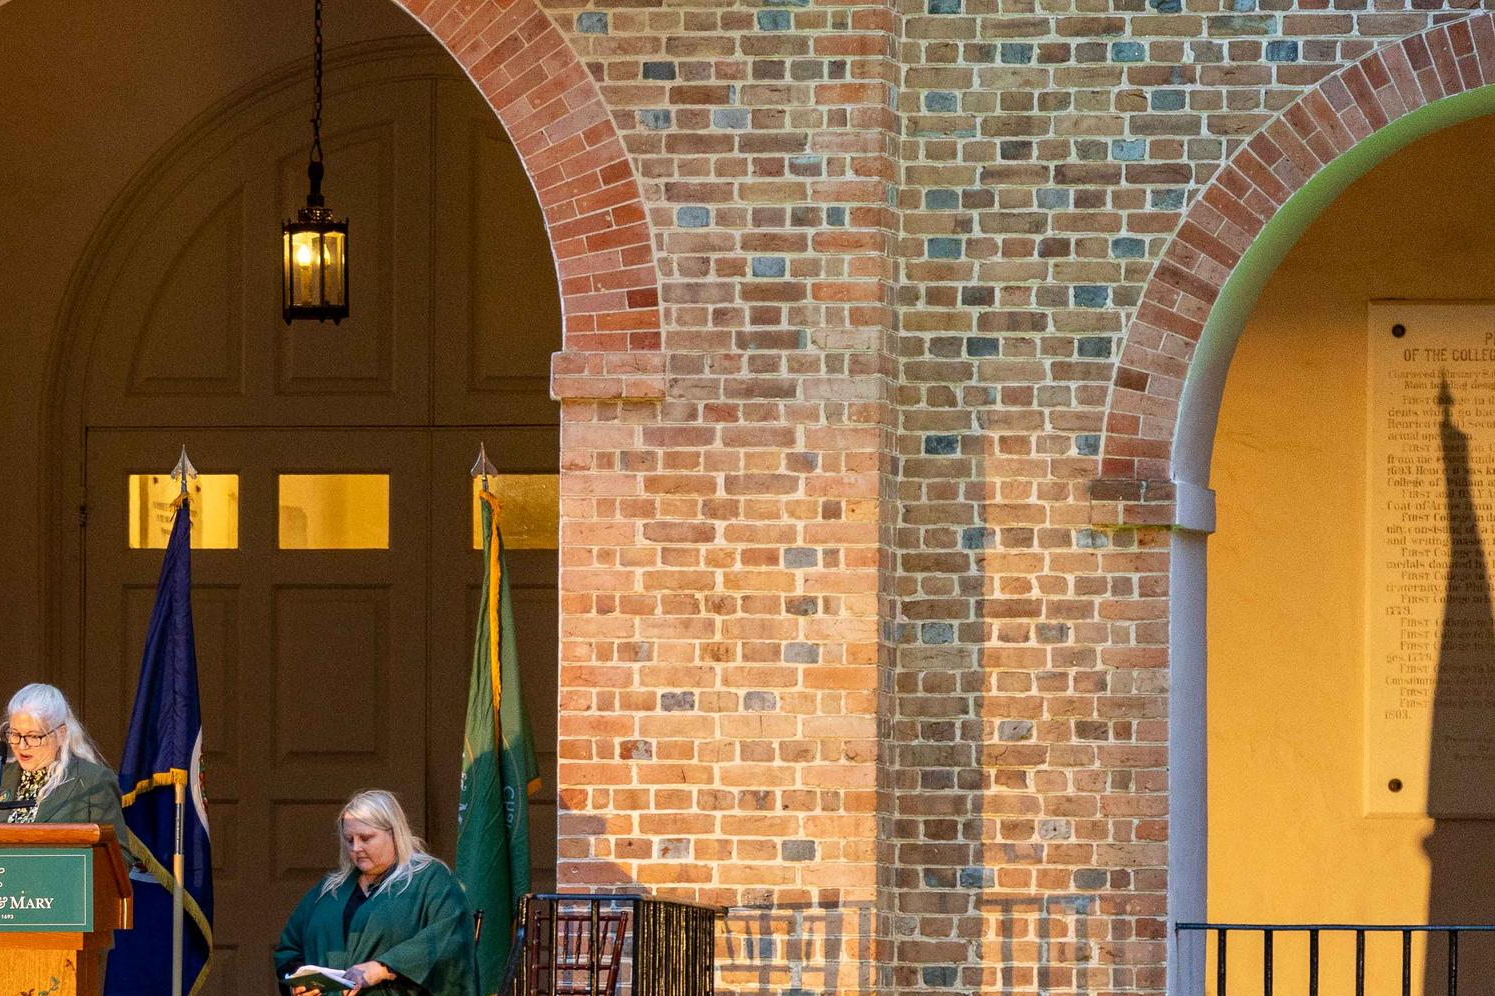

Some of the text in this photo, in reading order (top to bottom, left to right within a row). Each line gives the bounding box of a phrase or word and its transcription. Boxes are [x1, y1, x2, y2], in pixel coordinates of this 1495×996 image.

[1404, 348, 1419, 361] OF
[1424, 348, 1447, 361] THE
[9, 896, 54, 910] MARY
